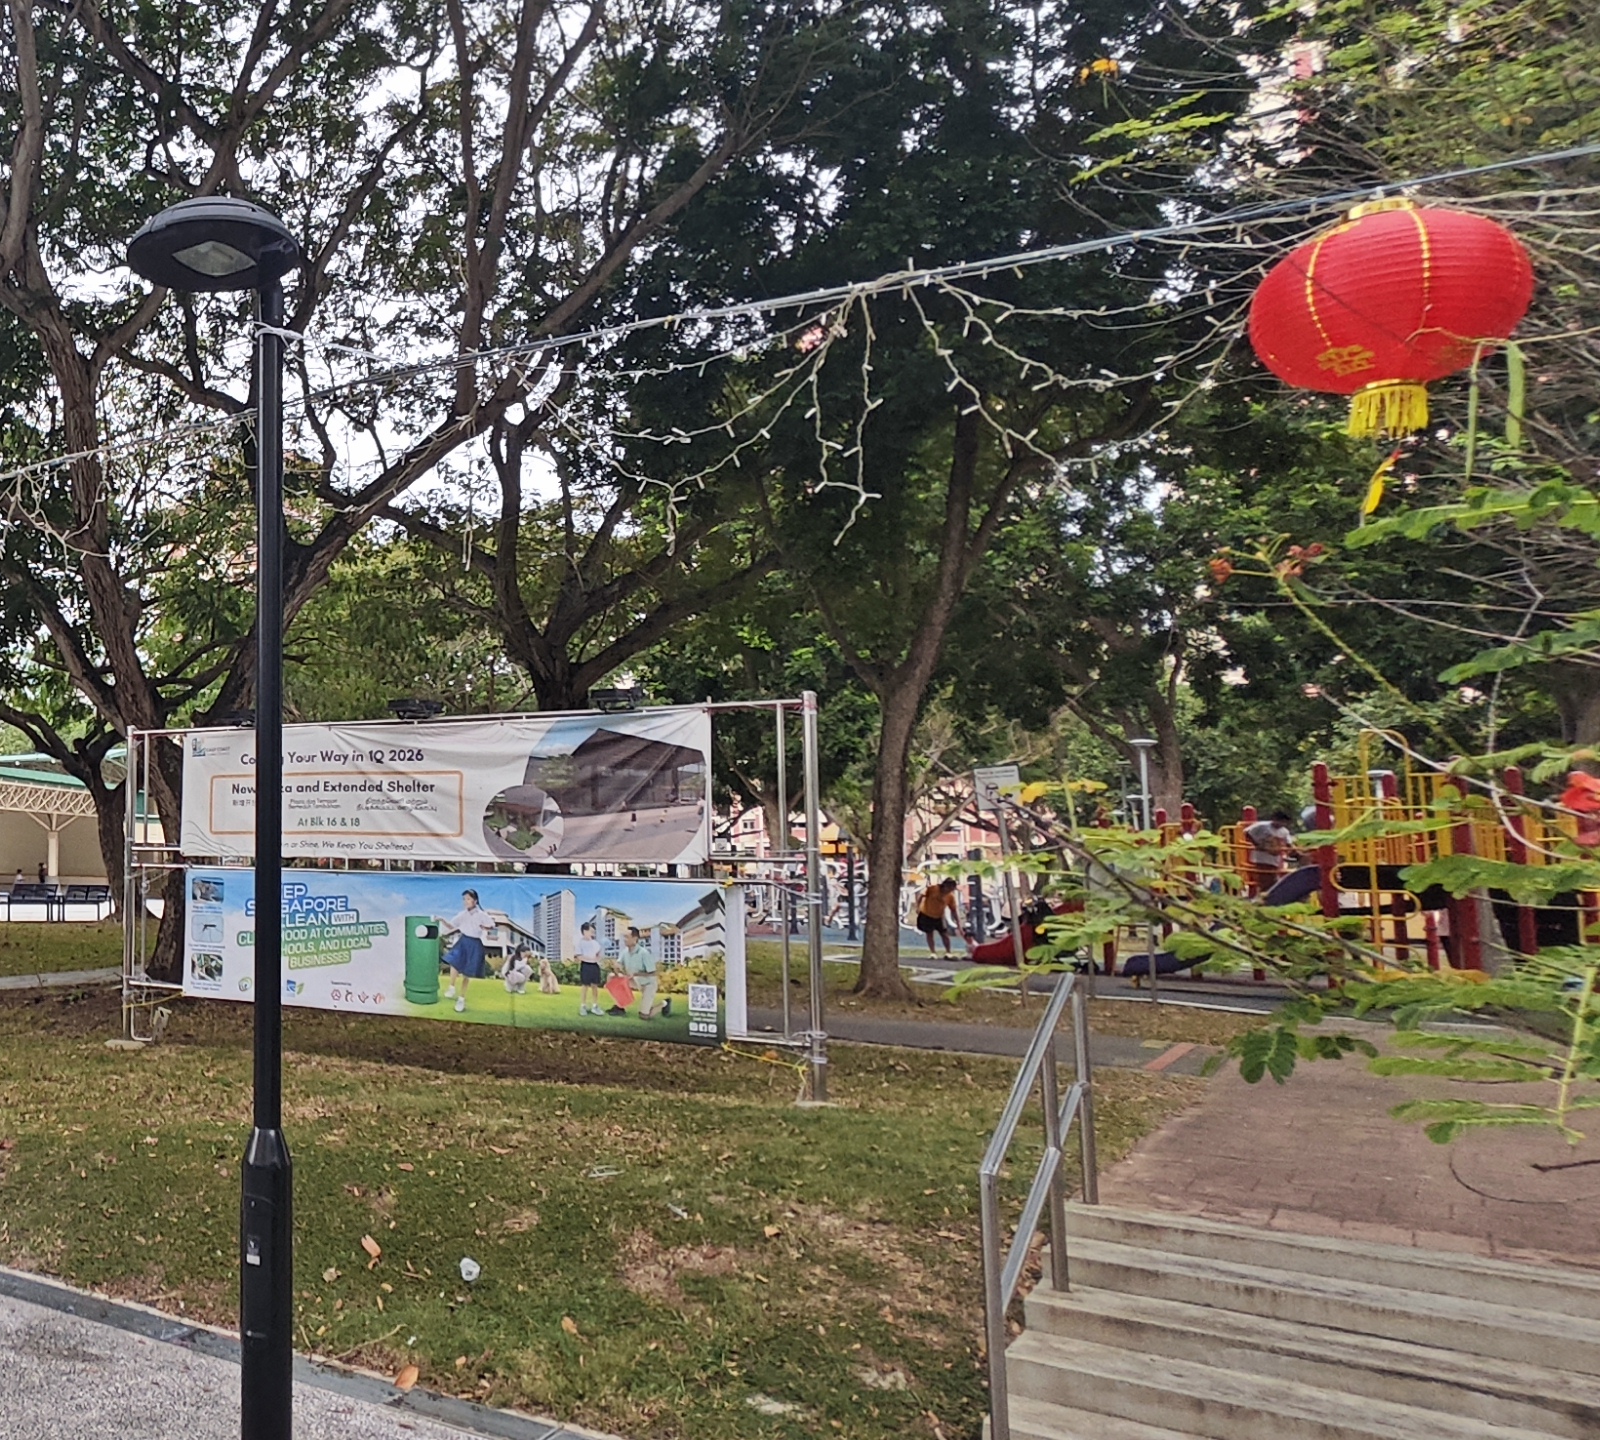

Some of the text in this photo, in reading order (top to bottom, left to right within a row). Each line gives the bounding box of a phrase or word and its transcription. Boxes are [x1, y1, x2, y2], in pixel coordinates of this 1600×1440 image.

[288, 749, 424, 766] Your Way in 1Q 2026
[296, 780, 320, 793] and
[323, 780, 383, 793] Extended
[386, 780, 436, 793] Shelter
[297, 816, 360, 827] At Blk 16 & 18
[322, 840, 335, 849] We
[337, 841, 356, 851] Keep
[359, 841, 373, 850] You
[283, 885, 306, 899] EP
[282, 912, 356, 928] LEAN WITH
[310, 928, 321, 939] AT
[319, 939, 340, 951] AND
[342, 937, 370, 949] LOCAL
[289, 951, 350, 969] BUSINESSES
